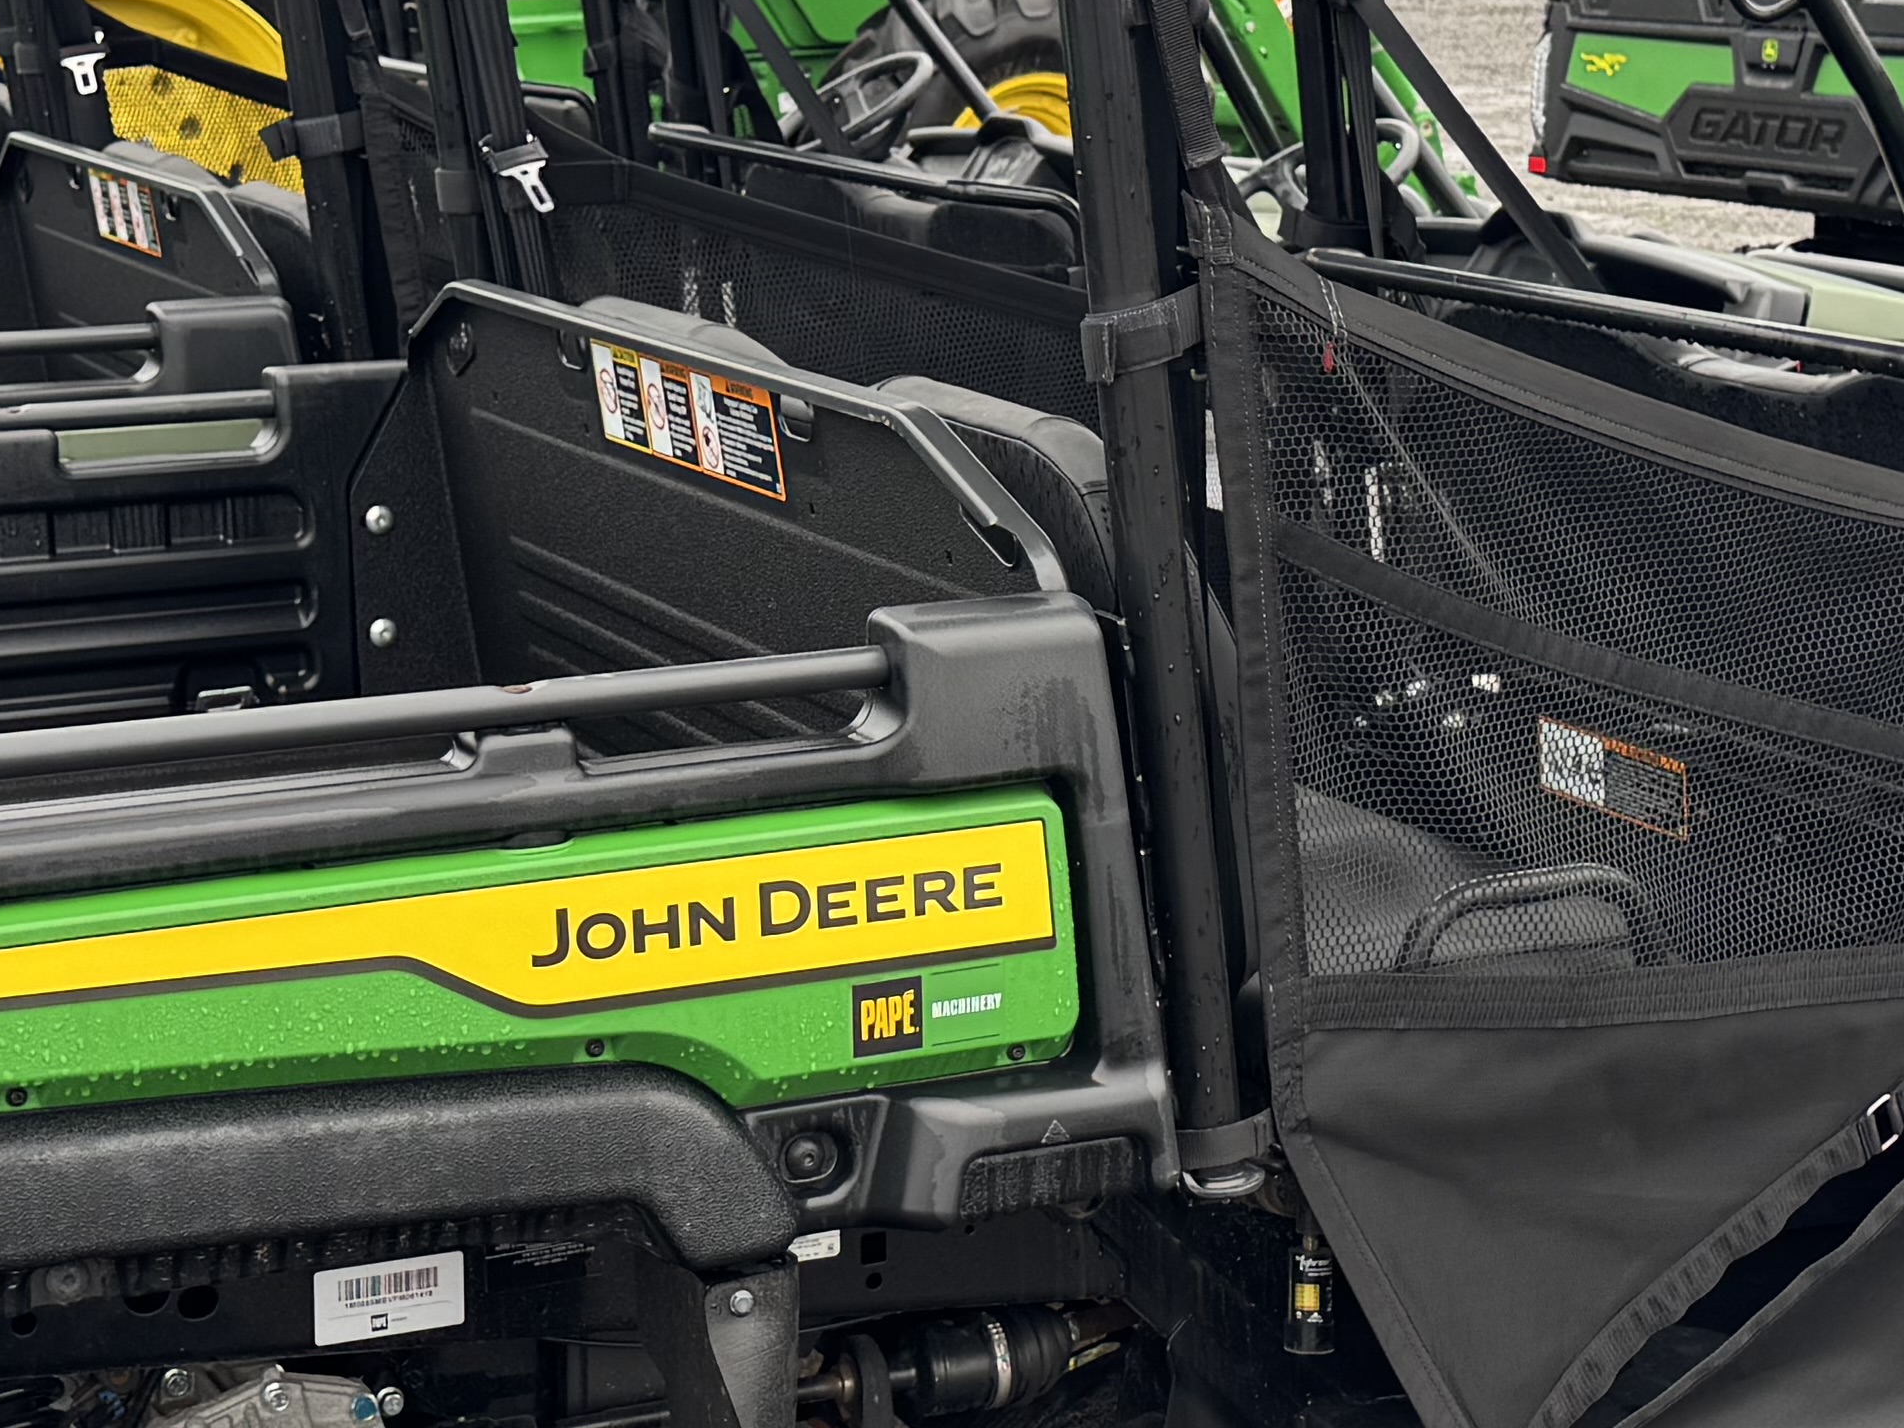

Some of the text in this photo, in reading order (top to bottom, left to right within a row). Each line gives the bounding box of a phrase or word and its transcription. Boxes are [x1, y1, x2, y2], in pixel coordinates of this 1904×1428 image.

[1690, 105, 1848, 157] GATOR
[531, 863, 1004, 968] JOHN DEERE
[931, 992, 1003, 1019] MACHINERY
